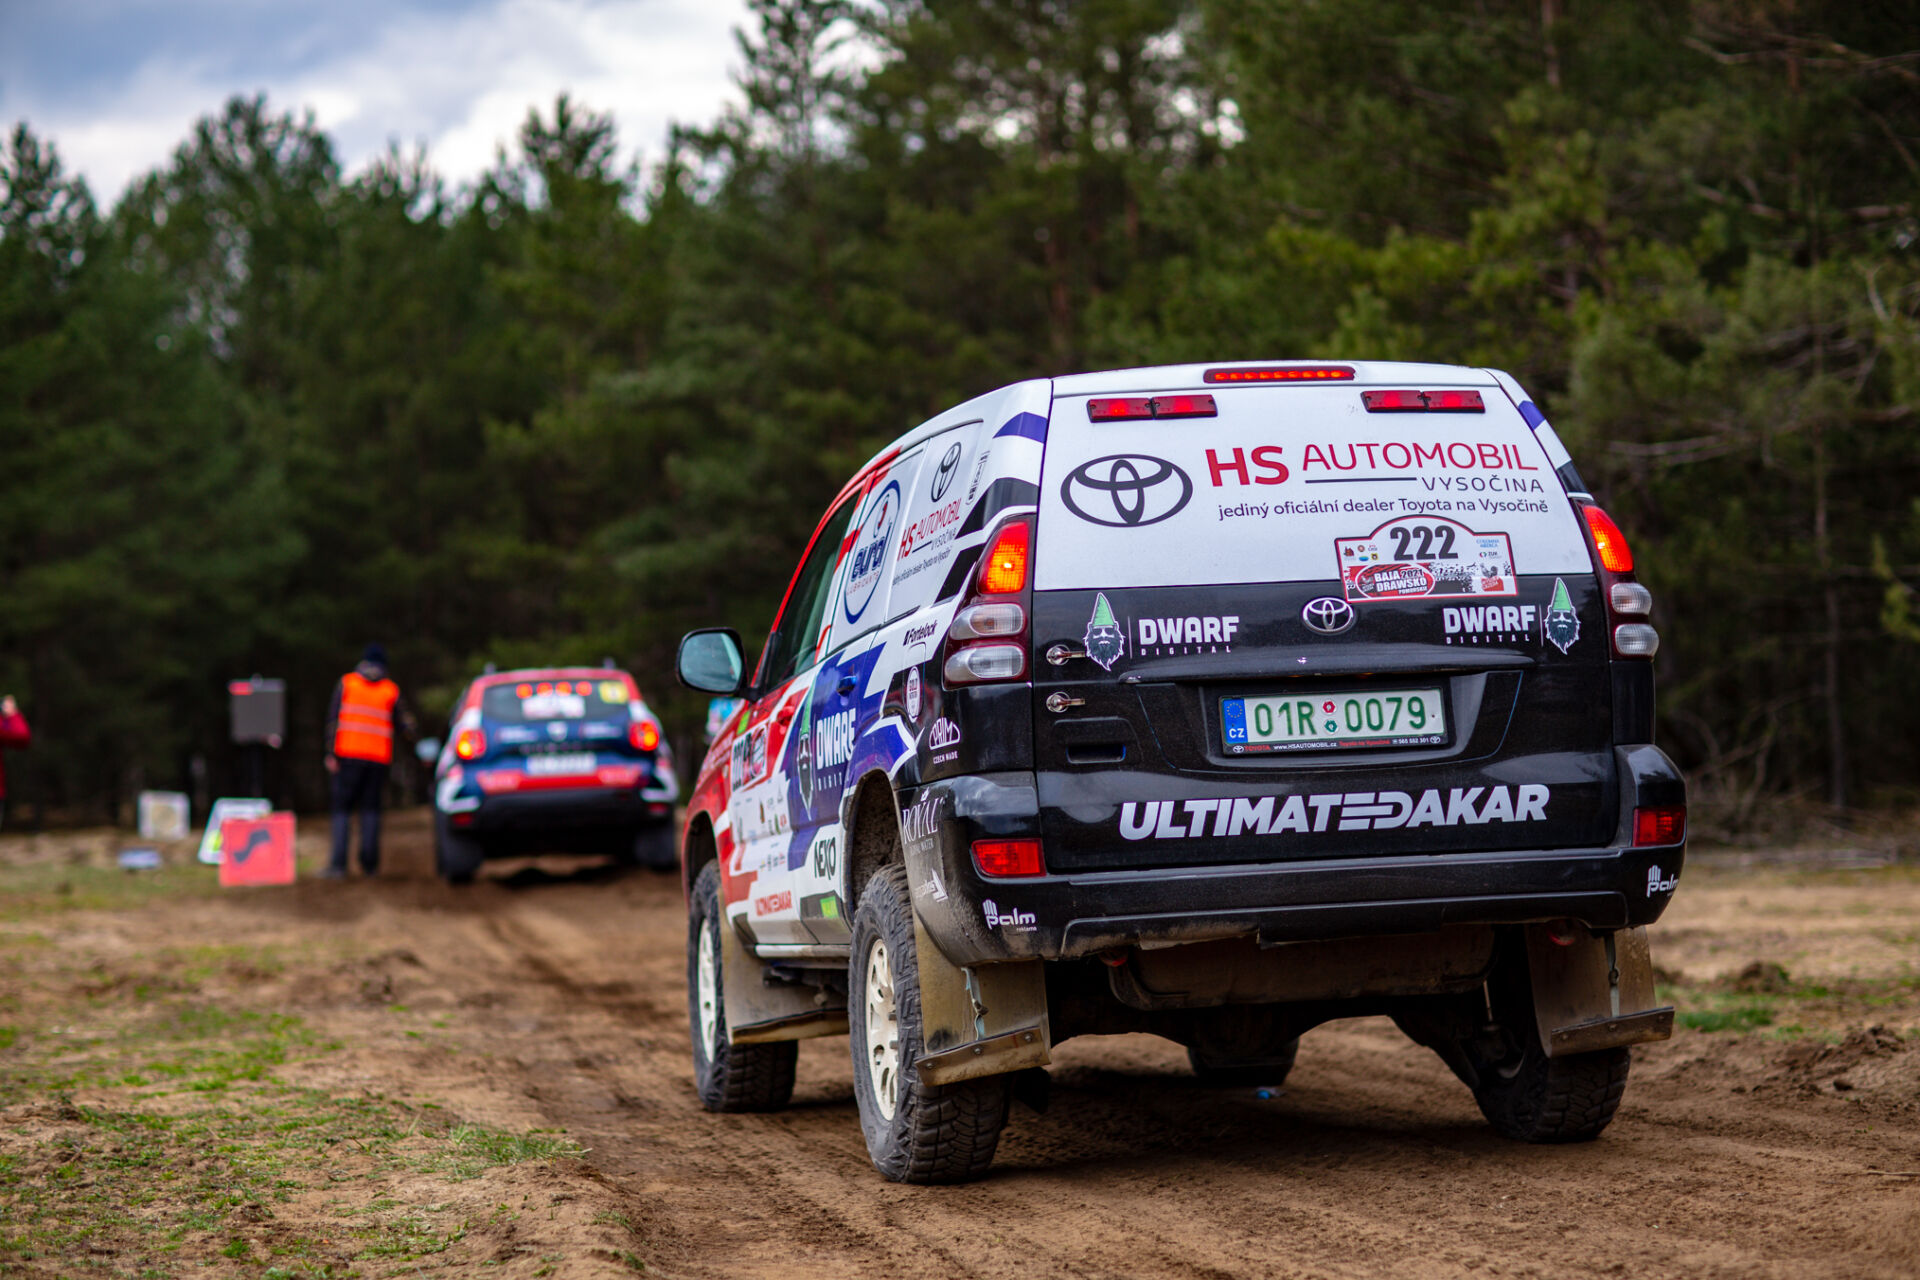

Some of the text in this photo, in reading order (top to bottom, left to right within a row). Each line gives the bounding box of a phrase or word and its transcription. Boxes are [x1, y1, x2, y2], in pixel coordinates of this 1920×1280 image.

[1205, 442, 1539, 487] HS AUTOMOBIL
[1422, 475, 1545, 493] VYSOČINA
[1218, 502, 1269, 521] jediný
[1273, 500, 1340, 515] oficiální
[1343, 498, 1395, 512] dealer
[1398, 498, 1452, 514] Toyota
[1478, 498, 1549, 514] Vysočině
[898, 523, 918, 562] HS
[915, 498, 962, 541] AUTOMOBIL
[1390, 525, 1459, 561] 222
[1374, 568, 1425, 582] BAJA 2021
[1376, 577, 1427, 592] DRAWSKO
[1138, 616, 1239, 646] DWARF
[1443, 605, 1536, 634] DWARF
[1141, 645, 1231, 656] DIGITAL
[1446, 634, 1530, 645] DIGITAL
[1254, 697, 1426, 737] 01R 0079
[816, 708, 856, 770] DWARF
[1229, 728, 1245, 738] CZ
[932, 755, 946, 765] CZECH
[814, 836, 837, 880] NEXO
[985, 906, 1036, 930] palm
